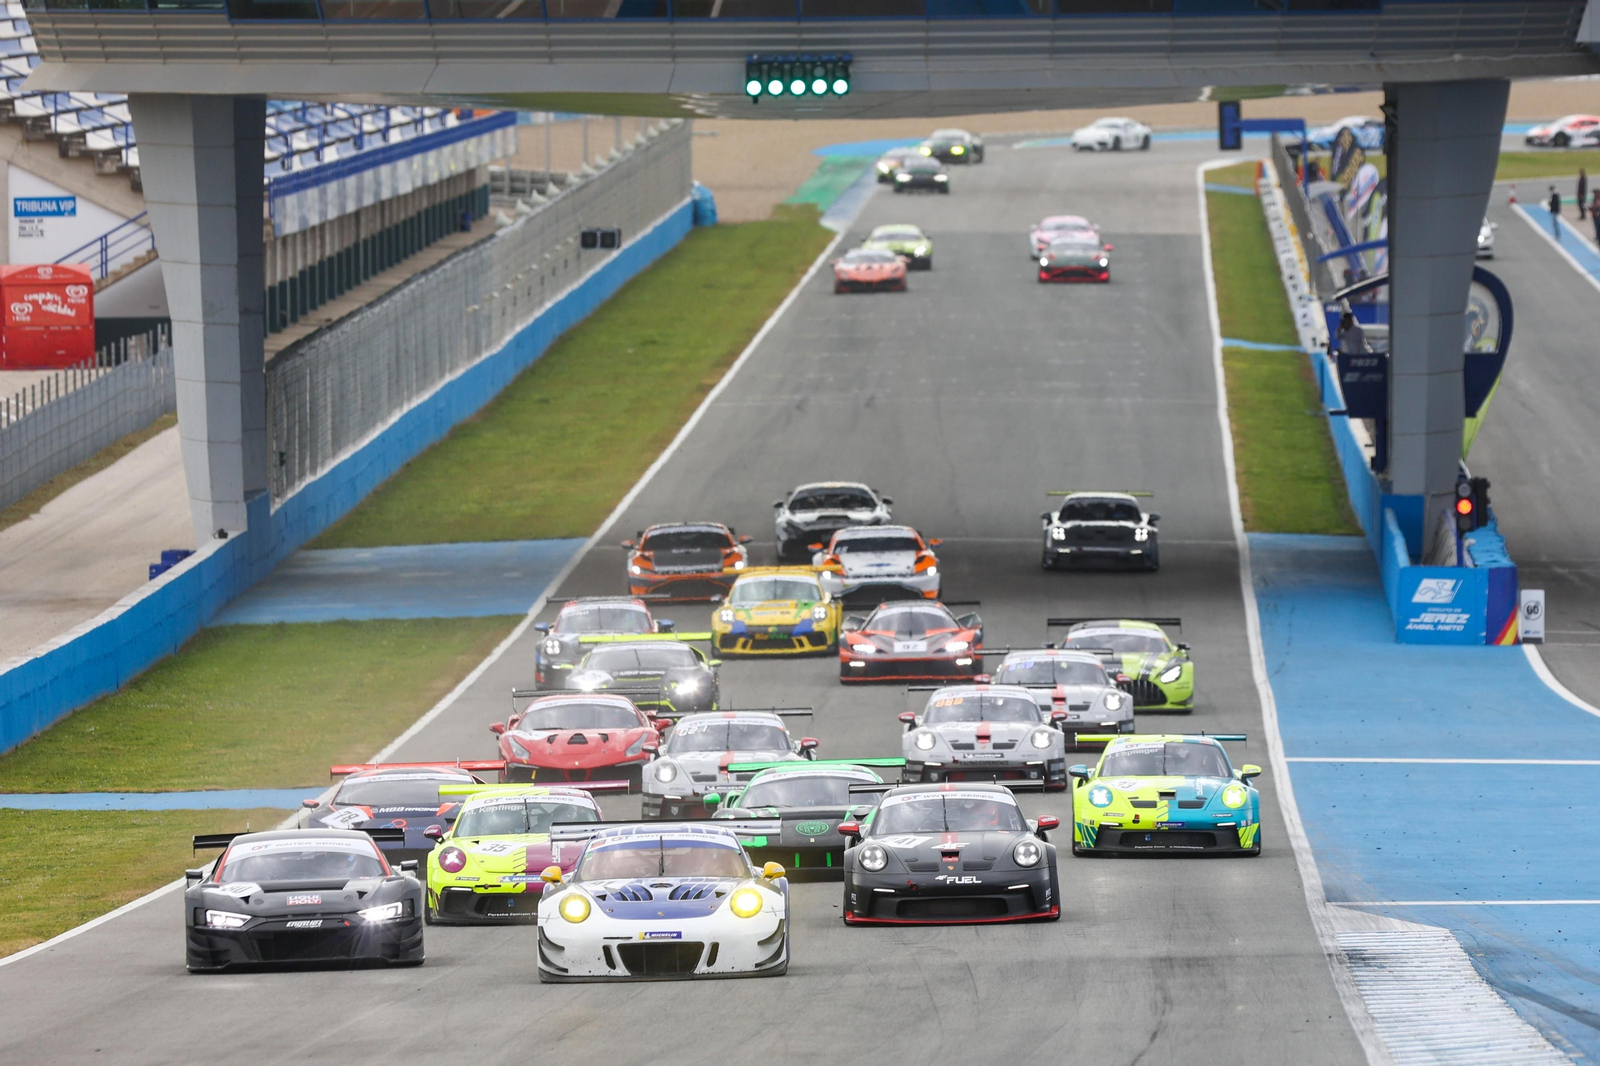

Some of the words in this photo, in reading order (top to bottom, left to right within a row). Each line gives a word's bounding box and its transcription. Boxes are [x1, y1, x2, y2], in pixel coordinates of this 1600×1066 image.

[16, 200, 58, 212] TRIBUNA
[59, 200, 74, 212] VIP
[1526, 604, 1540, 614] 60
[1409, 613, 1470, 624] JEREZ
[482, 843, 512, 852] 35
[947, 876, 982, 884] FUEL
